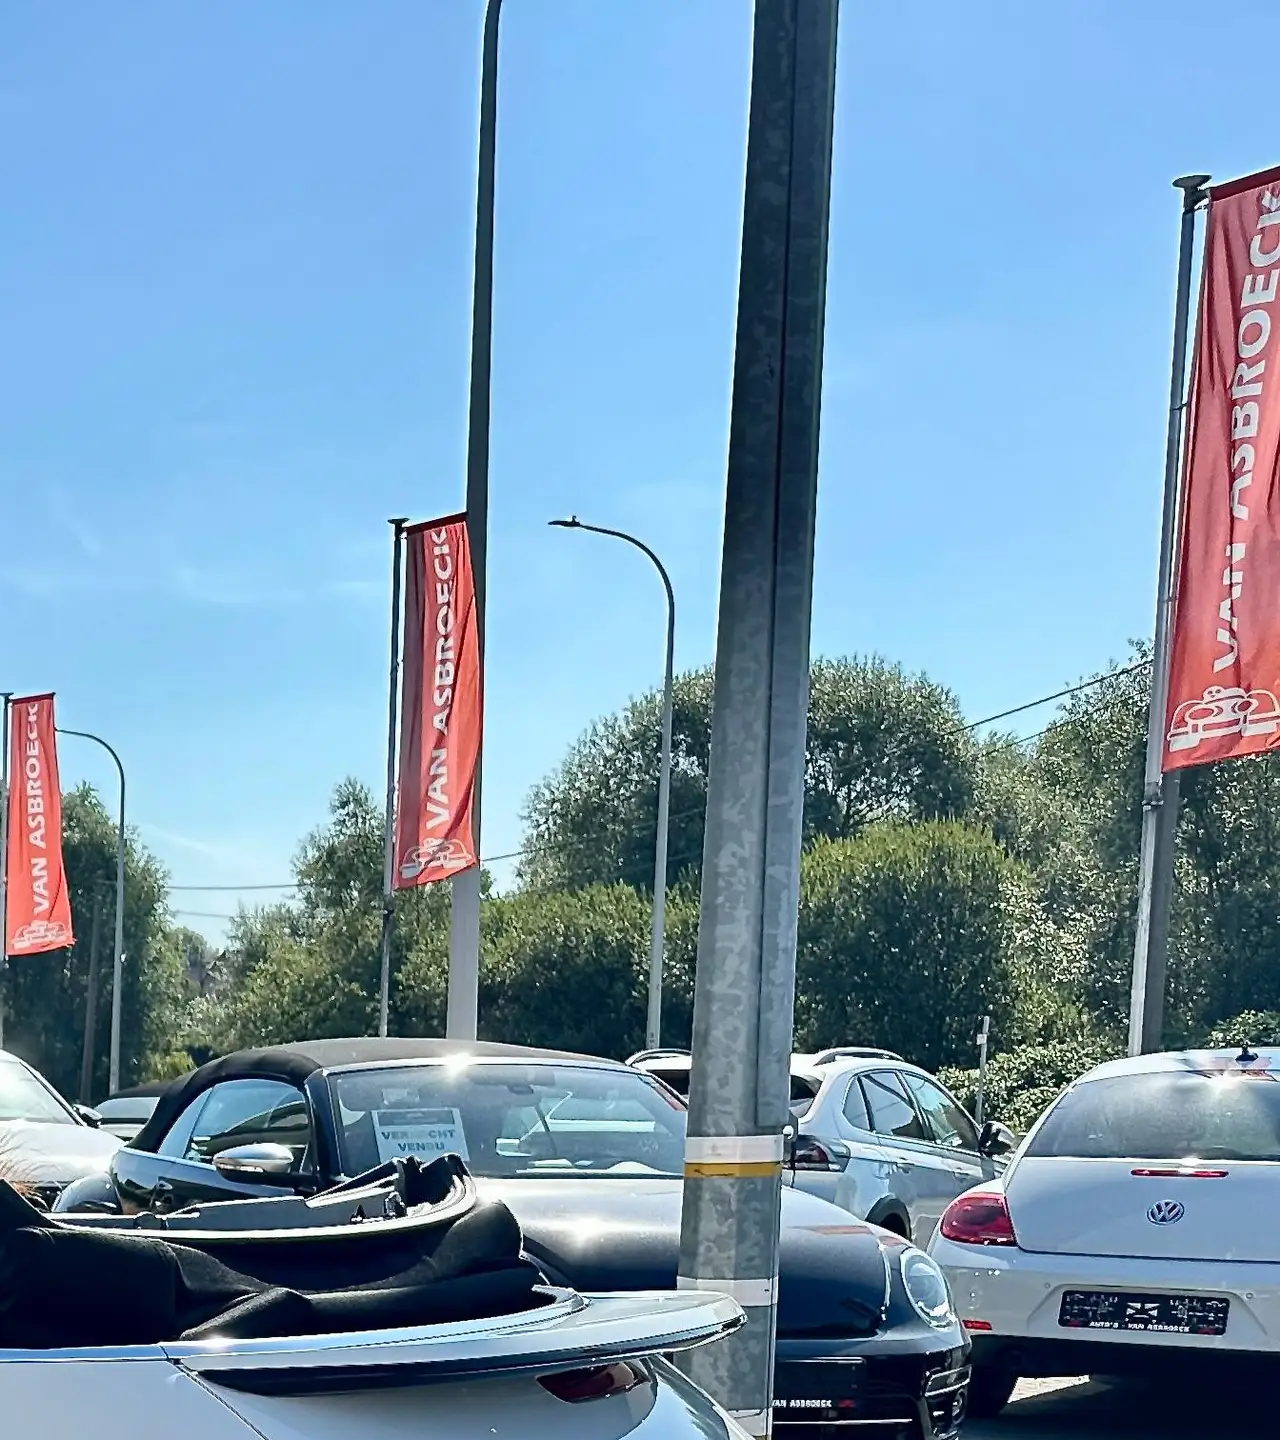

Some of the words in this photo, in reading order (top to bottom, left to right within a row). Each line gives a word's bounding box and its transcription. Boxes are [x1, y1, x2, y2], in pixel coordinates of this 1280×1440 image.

[432, 526, 456, 737] ASBROECK
[1212, 543, 1246, 673] VAN
[25, 702, 47, 850] ASBROECK
[425, 749, 451, 835] VAN
[30, 857, 50, 915] VAN
[398, 1142, 445, 1152] VENDU
